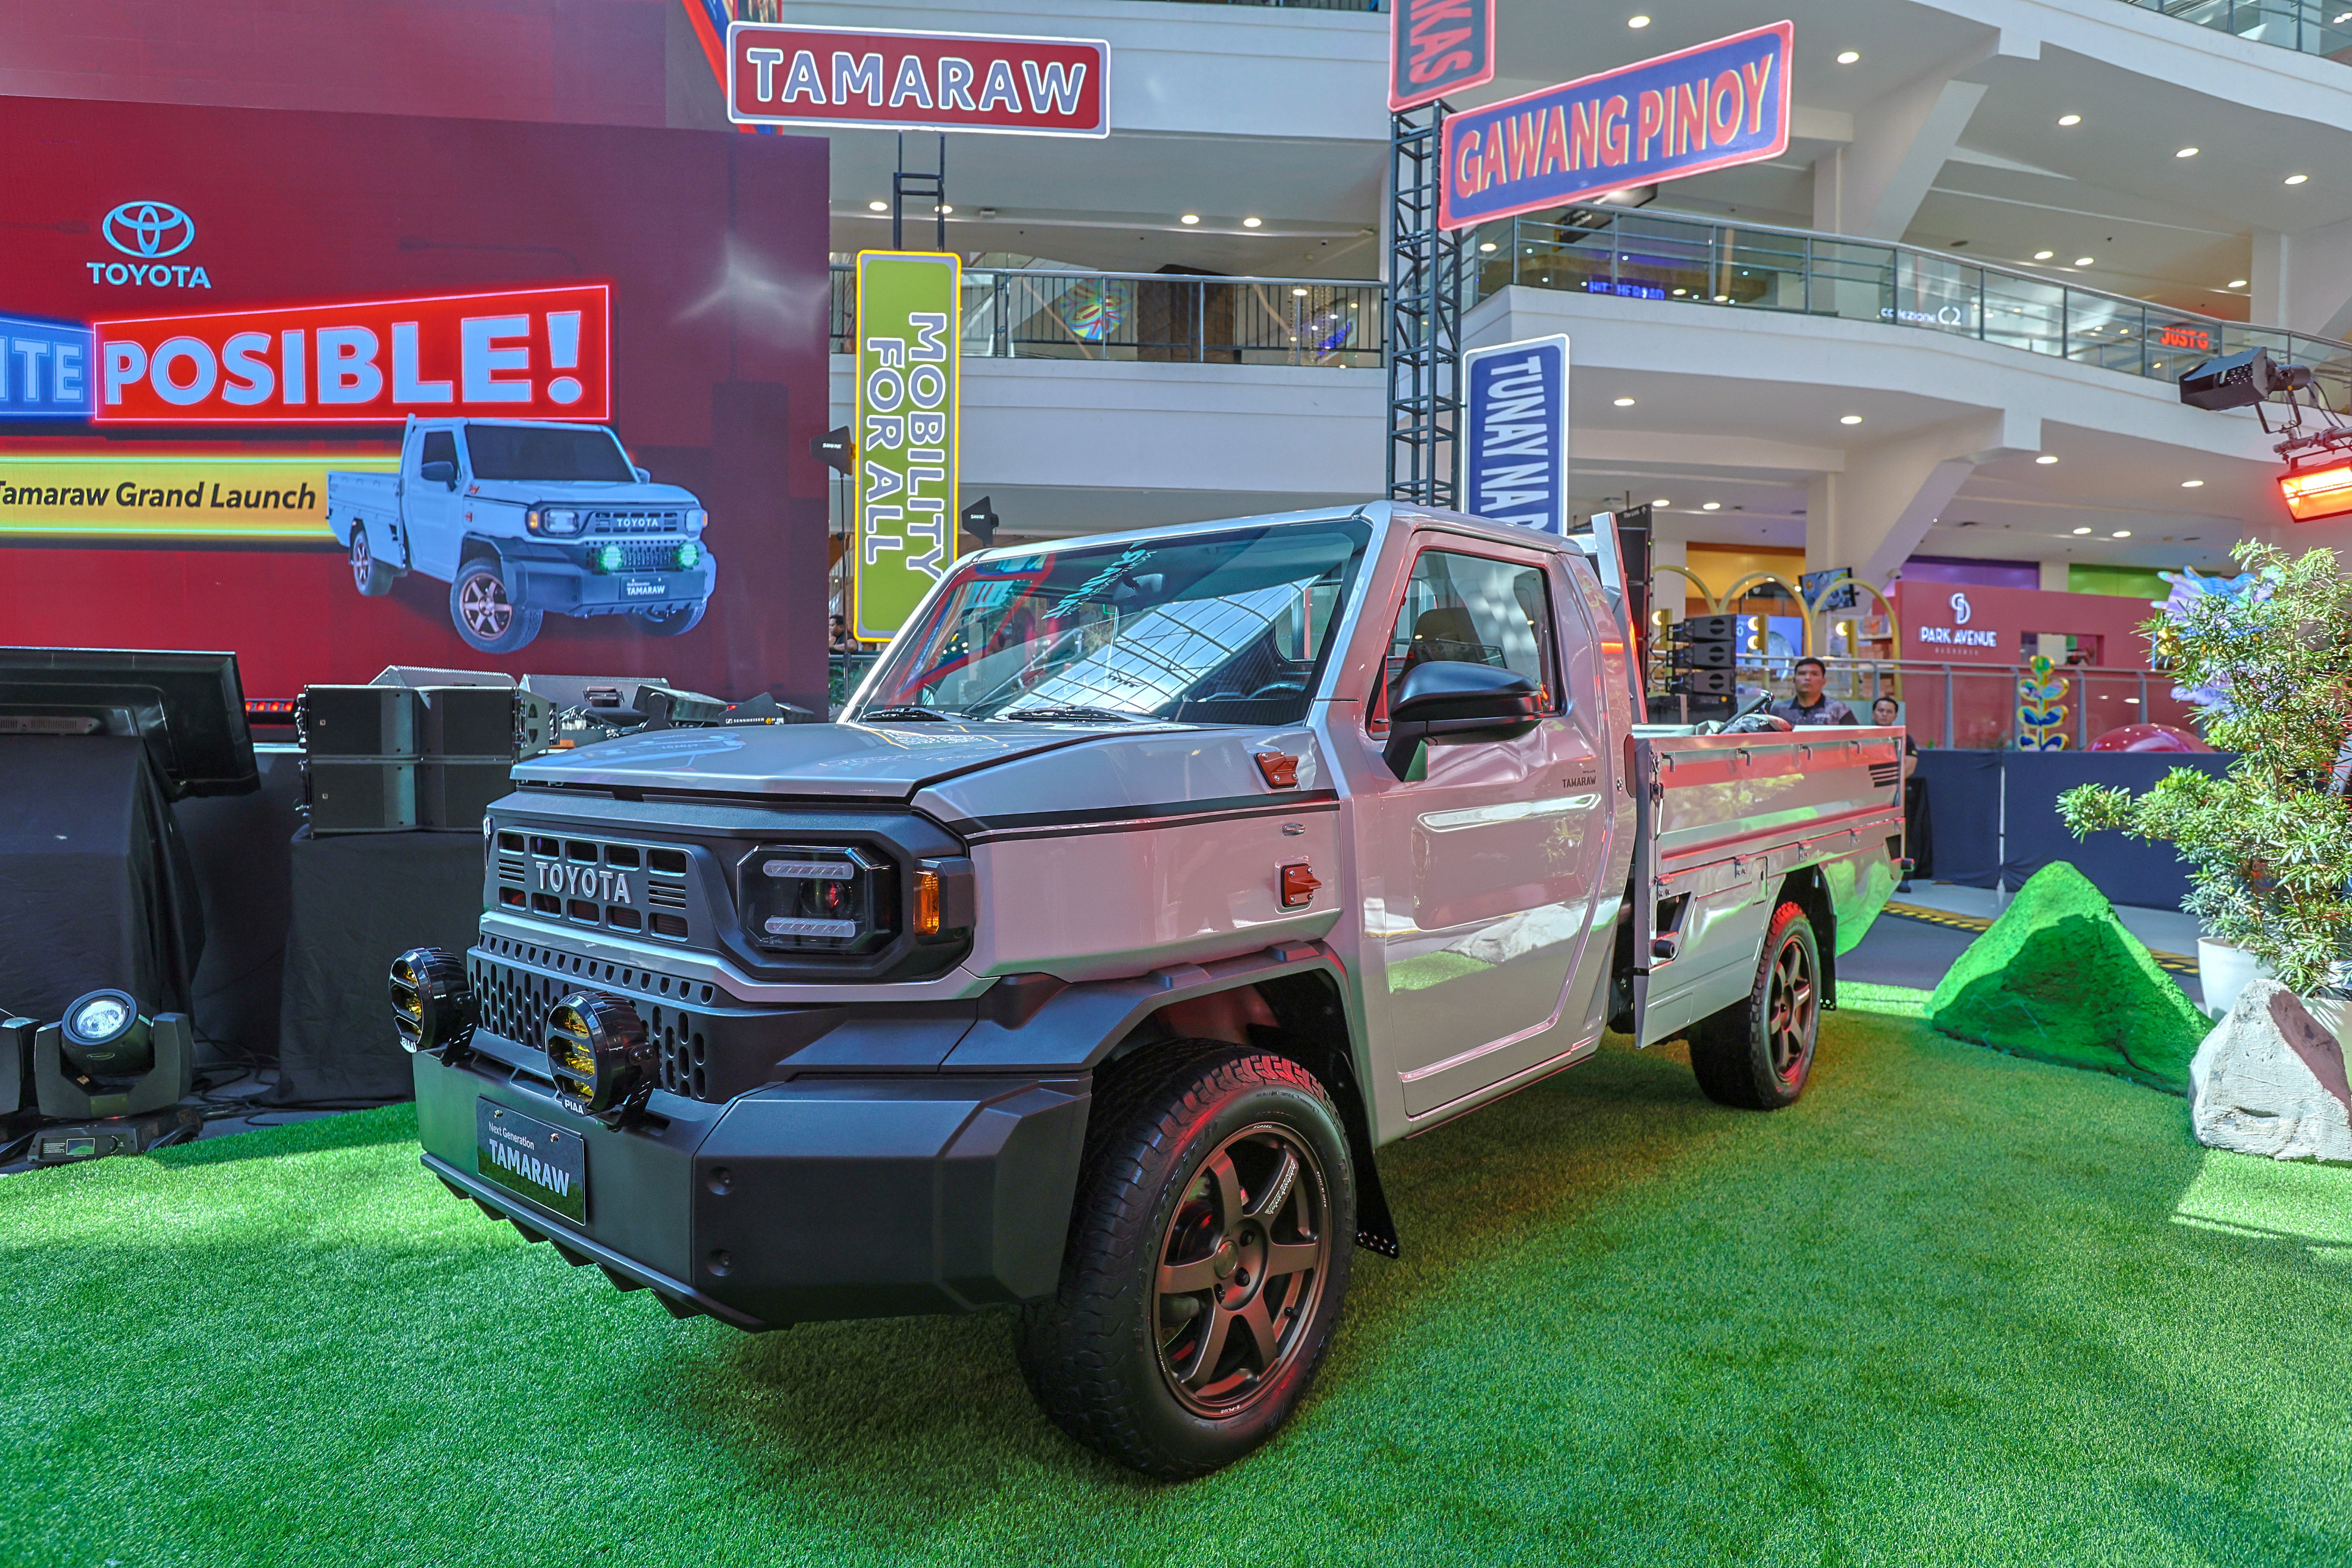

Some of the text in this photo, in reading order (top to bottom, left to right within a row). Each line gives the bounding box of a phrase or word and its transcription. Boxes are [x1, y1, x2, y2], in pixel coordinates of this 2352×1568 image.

[747, 47, 1086, 115] TAMARAW
[1455, 53, 1773, 199] GAWANG PINOY
[87, 261, 212, 289] TOYOTA
[2160, 326, 2209, 350] JUST G
[103, 310, 583, 406] POSIBLE!
[1482, 356, 1549, 457] TUNAY
[866, 337, 905, 564] FOR ALL
[906, 312, 947, 581] MOBILITY
[116, 482, 205, 508] Grand
[211, 483, 315, 510] Launch
[617, 519, 659, 527] TOYOTA
[626, 585, 666, 595] TAMARAW
[1921, 626, 1997, 647] PARK AVENUE
[1562, 776, 1596, 788] TAMARAW
[536, 861, 631, 904] TOYOTA
[564, 1100, 584, 1115] PIAA
[489, 1122, 534, 1151] Next Generation
[489, 1138, 570, 1197] TAMARAW
[1220, 1405, 1240, 1414] S-PLUS
